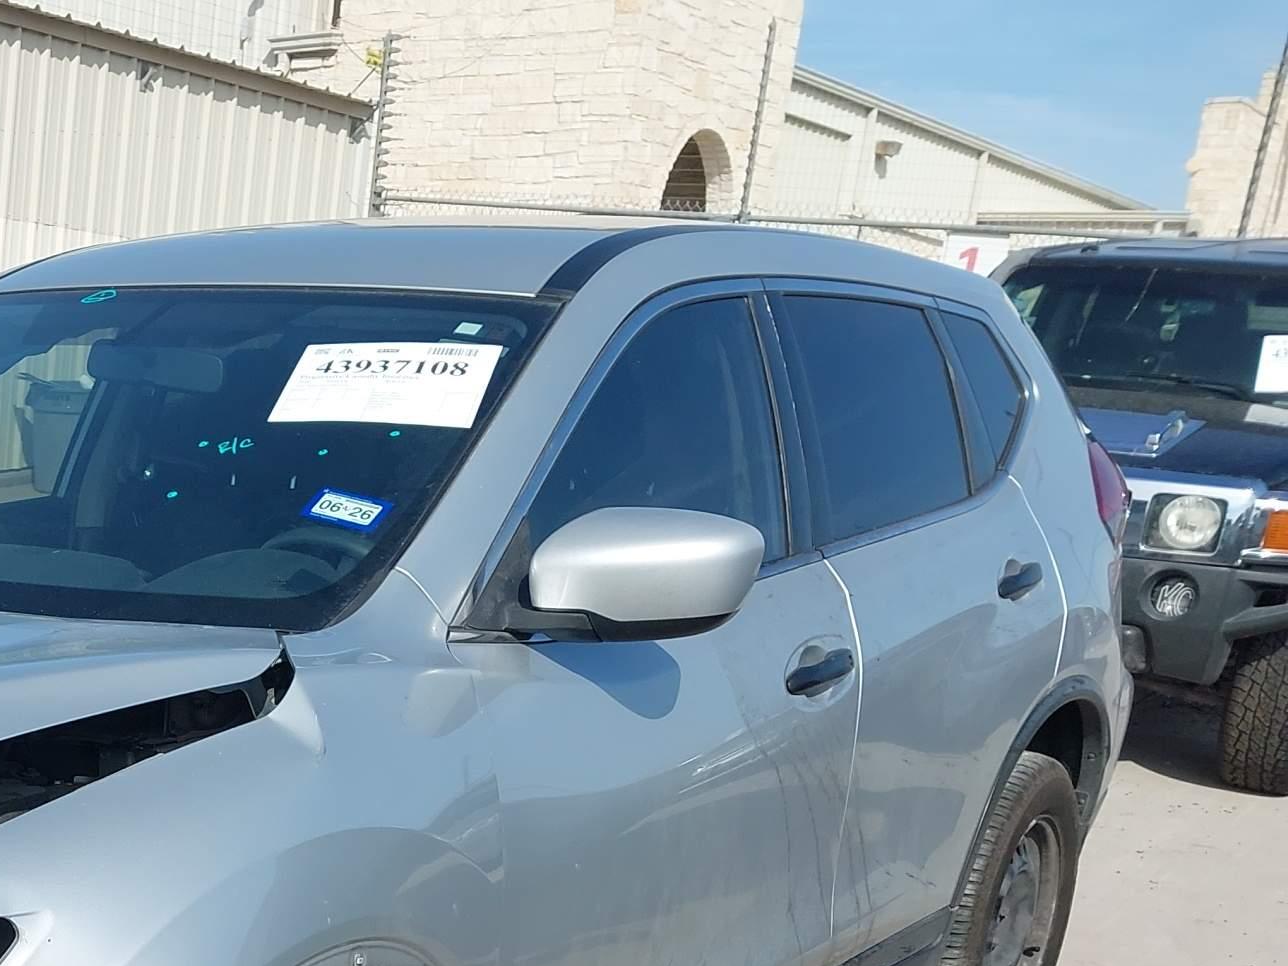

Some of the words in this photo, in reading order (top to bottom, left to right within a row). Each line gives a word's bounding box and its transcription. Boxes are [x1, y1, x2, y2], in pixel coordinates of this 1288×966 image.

[315, 359, 470, 377] 43937108
[319, 499, 343, 512] 06
[347, 506, 374, 520] 26
